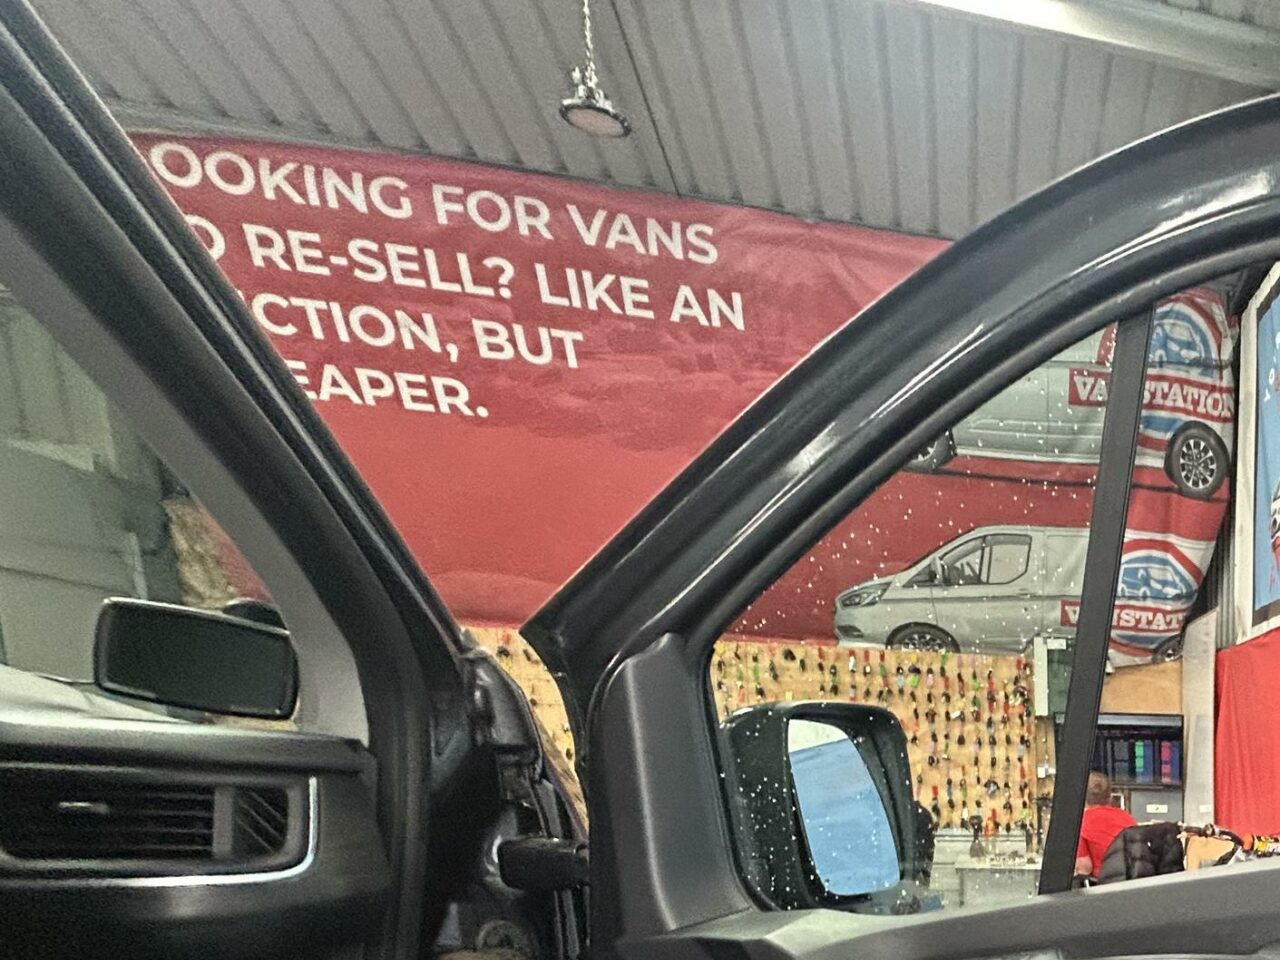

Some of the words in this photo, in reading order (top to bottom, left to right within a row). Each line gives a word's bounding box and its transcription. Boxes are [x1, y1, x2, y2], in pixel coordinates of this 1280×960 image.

[150, 141, 413, 219] OOKING
[431, 182, 553, 240] FOR
[566, 203, 720, 266] VANS
[183, 213, 226, 262] O
[242, 222, 515, 300] RE-SELL?
[535, 262, 654, 320] LIKE
[669, 283, 745, 331] AN
[250, 292, 460, 363] CTION,
[471, 318, 583, 369] BUT
[283, 360, 489, 418] EAPER.
[1074, 375, 1235, 418] VATATION
